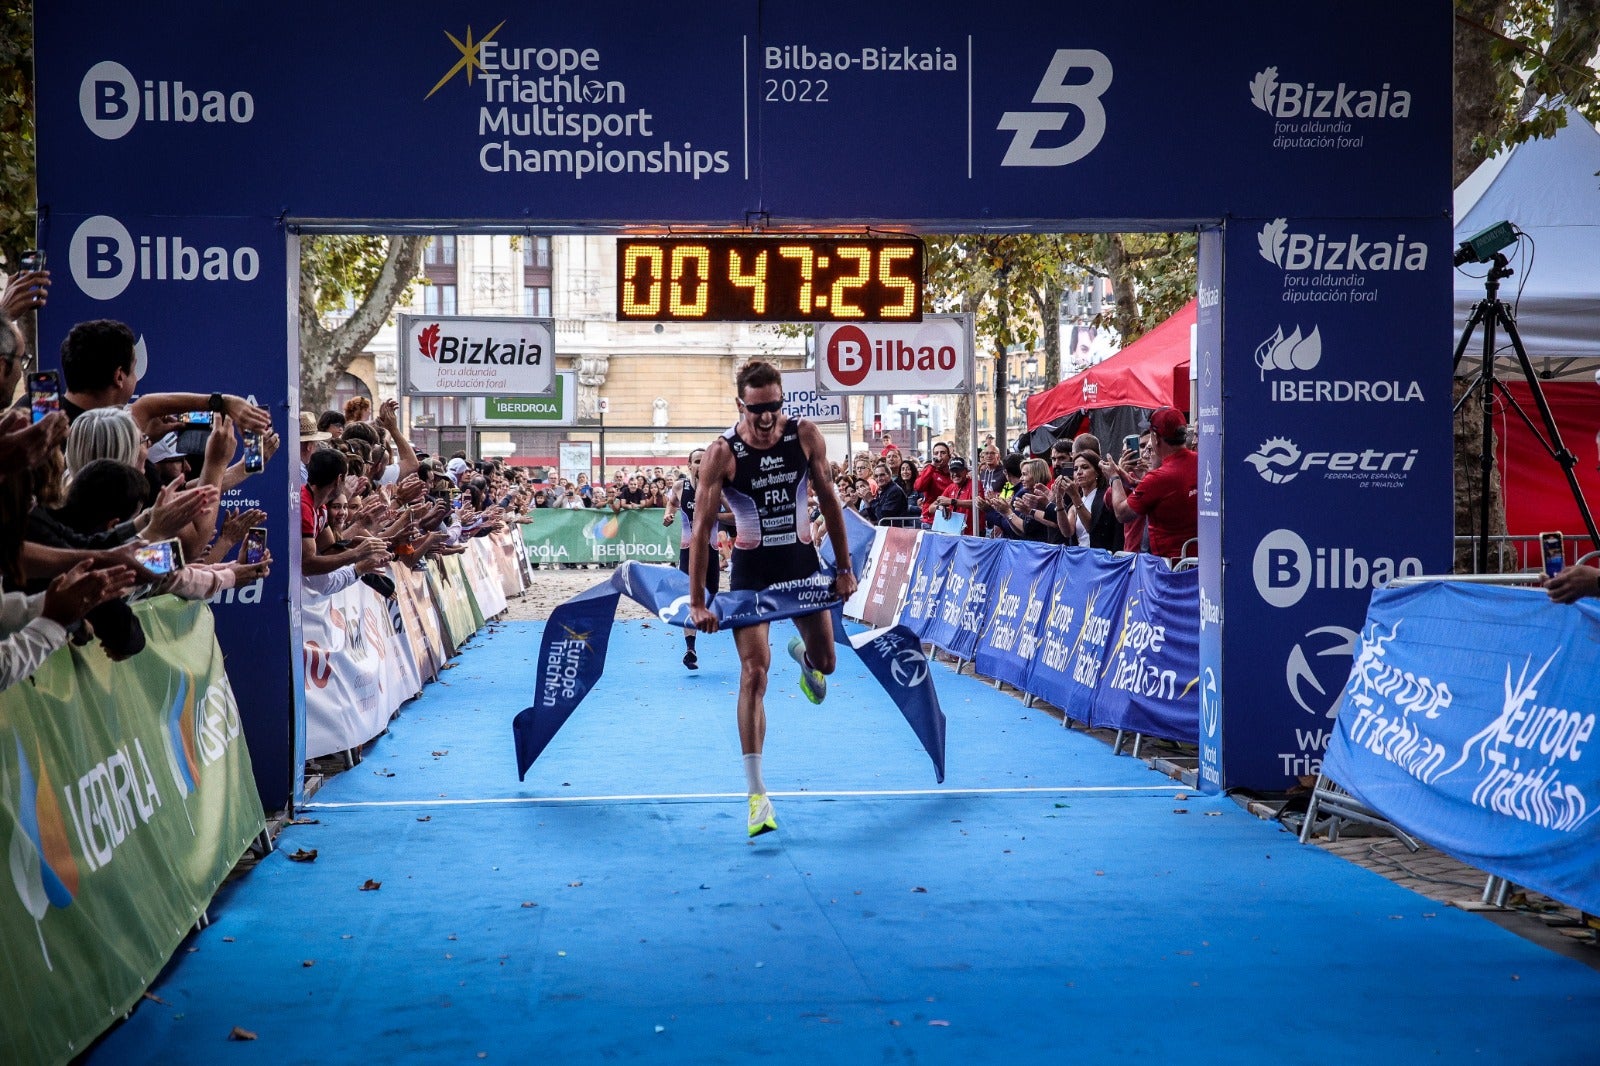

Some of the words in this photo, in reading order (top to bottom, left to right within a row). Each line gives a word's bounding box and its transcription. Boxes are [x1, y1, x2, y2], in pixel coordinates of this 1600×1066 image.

[478, 41, 600, 75] Europe
[764, 45, 958, 72] Bilbao-Bizkaia
[93, 79, 255, 124] Bilbao
[479, 74, 626, 105] Triathlon
[764, 79, 830, 103] 2022
[1275, 82, 1412, 119] Bizkaia
[479, 106, 653, 142] Multisport
[1274, 121, 1300, 135] foru
[1302, 121, 1352, 134] aldundia
[1273, 136, 1333, 150] diputación
[1336, 136, 1364, 149] foral
[479, 142, 730, 180] Championships
[84, 236, 261, 282] Bilbao
[1285, 233, 1429, 272] Bizkaia
[622, 245, 711, 317] 00
[729, 246, 916, 318] 47:25
[1283, 274, 1310, 288] foru
[1311, 274, 1365, 287] aldundia
[1282, 289, 1348, 304] diputación
[1349, 289, 1378, 302] foral
[438, 336, 542, 366] Bizkaia
[837, 338, 957, 372] Bilbao
[437, 367, 456, 377] foru
[457, 366, 497, 377] aldundia
[485, 379, 507, 389] foral
[1271, 381, 1425, 402] IBERDROLA
[497, 402, 557, 413] IBERDROLA
[781, 402, 840, 417] riathlon
[764, 488, 789, 506] FRA
[592, 543, 676, 557] IBERDROLA
[543, 640, 567, 708] Triathlon
[566, 639, 586, 699] Europe
[1498, 688, 1596, 767] Europe
